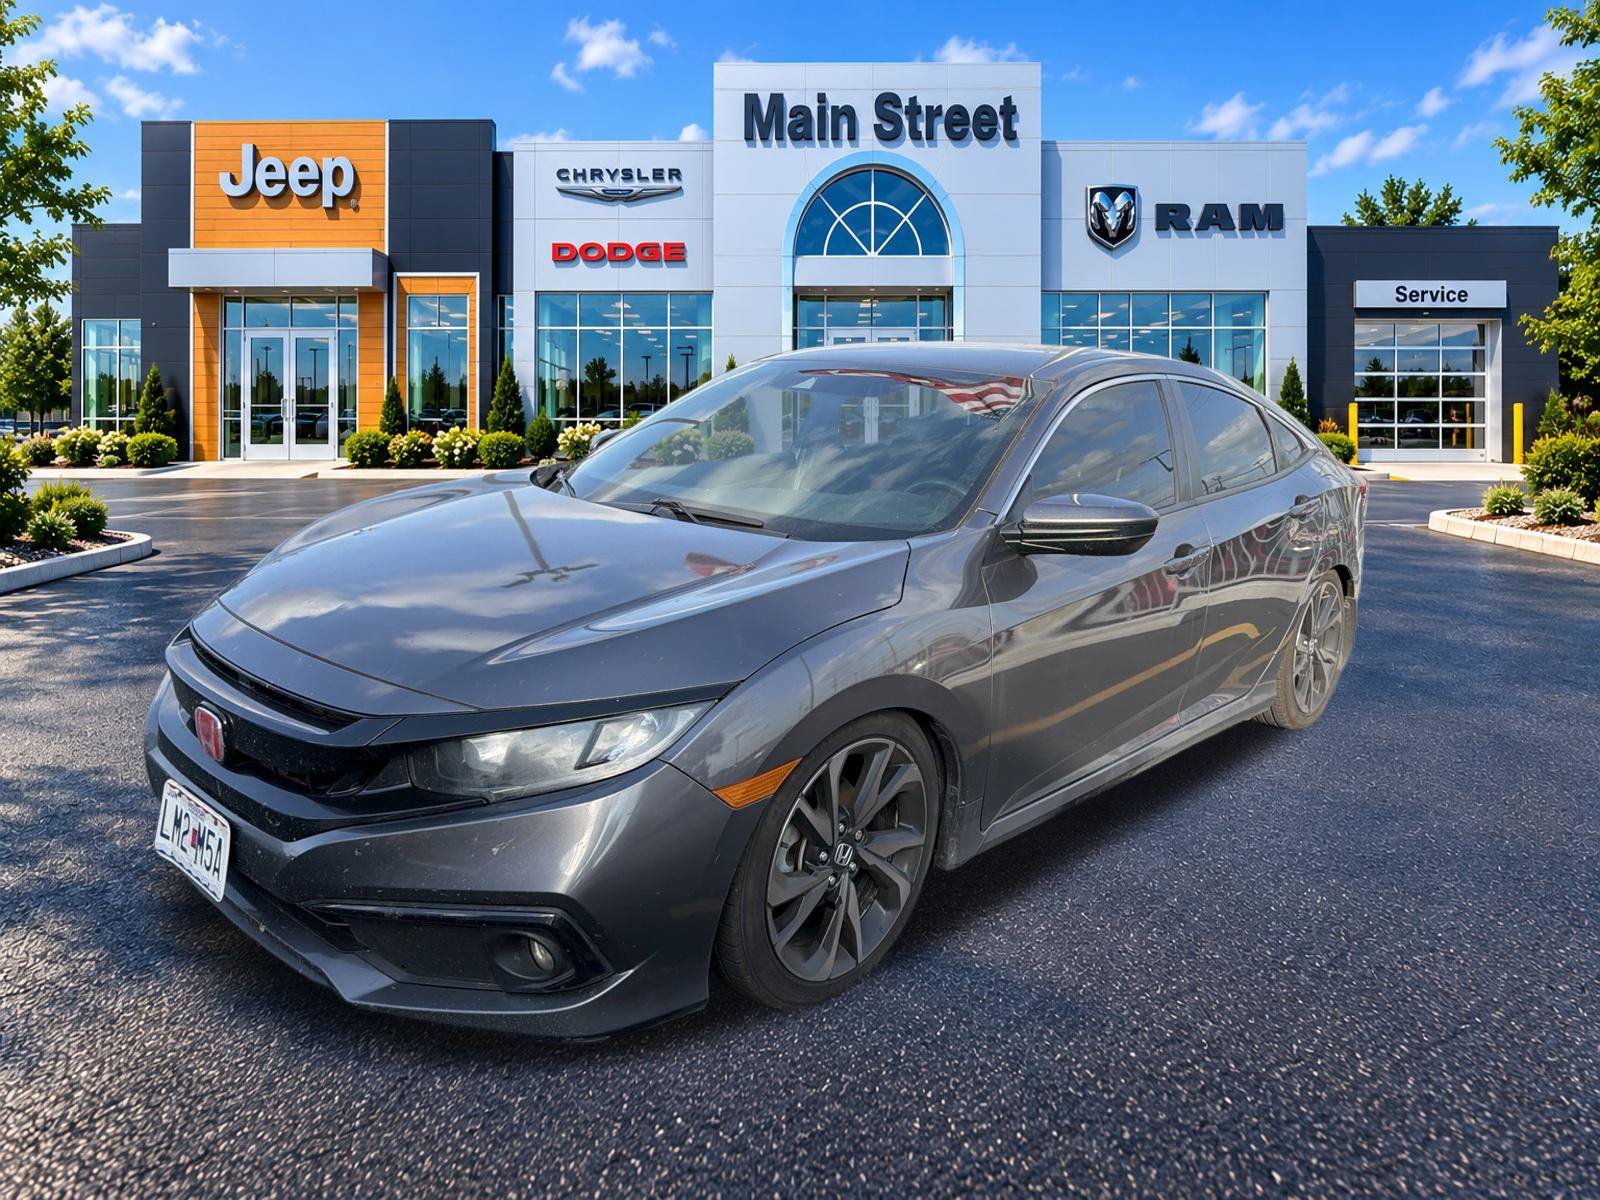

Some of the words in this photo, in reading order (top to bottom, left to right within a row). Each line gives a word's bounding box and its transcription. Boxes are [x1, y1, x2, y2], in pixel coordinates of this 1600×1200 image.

[744, 92, 856, 141] Main
[873, 91, 1017, 141] Street
[219, 143, 354, 208] Jeep
[556, 168, 682, 182] CHRYSLER
[1155, 203, 1284, 231] RAM
[551, 242, 686, 261] DODGE
[1395, 285, 1468, 303] Service
